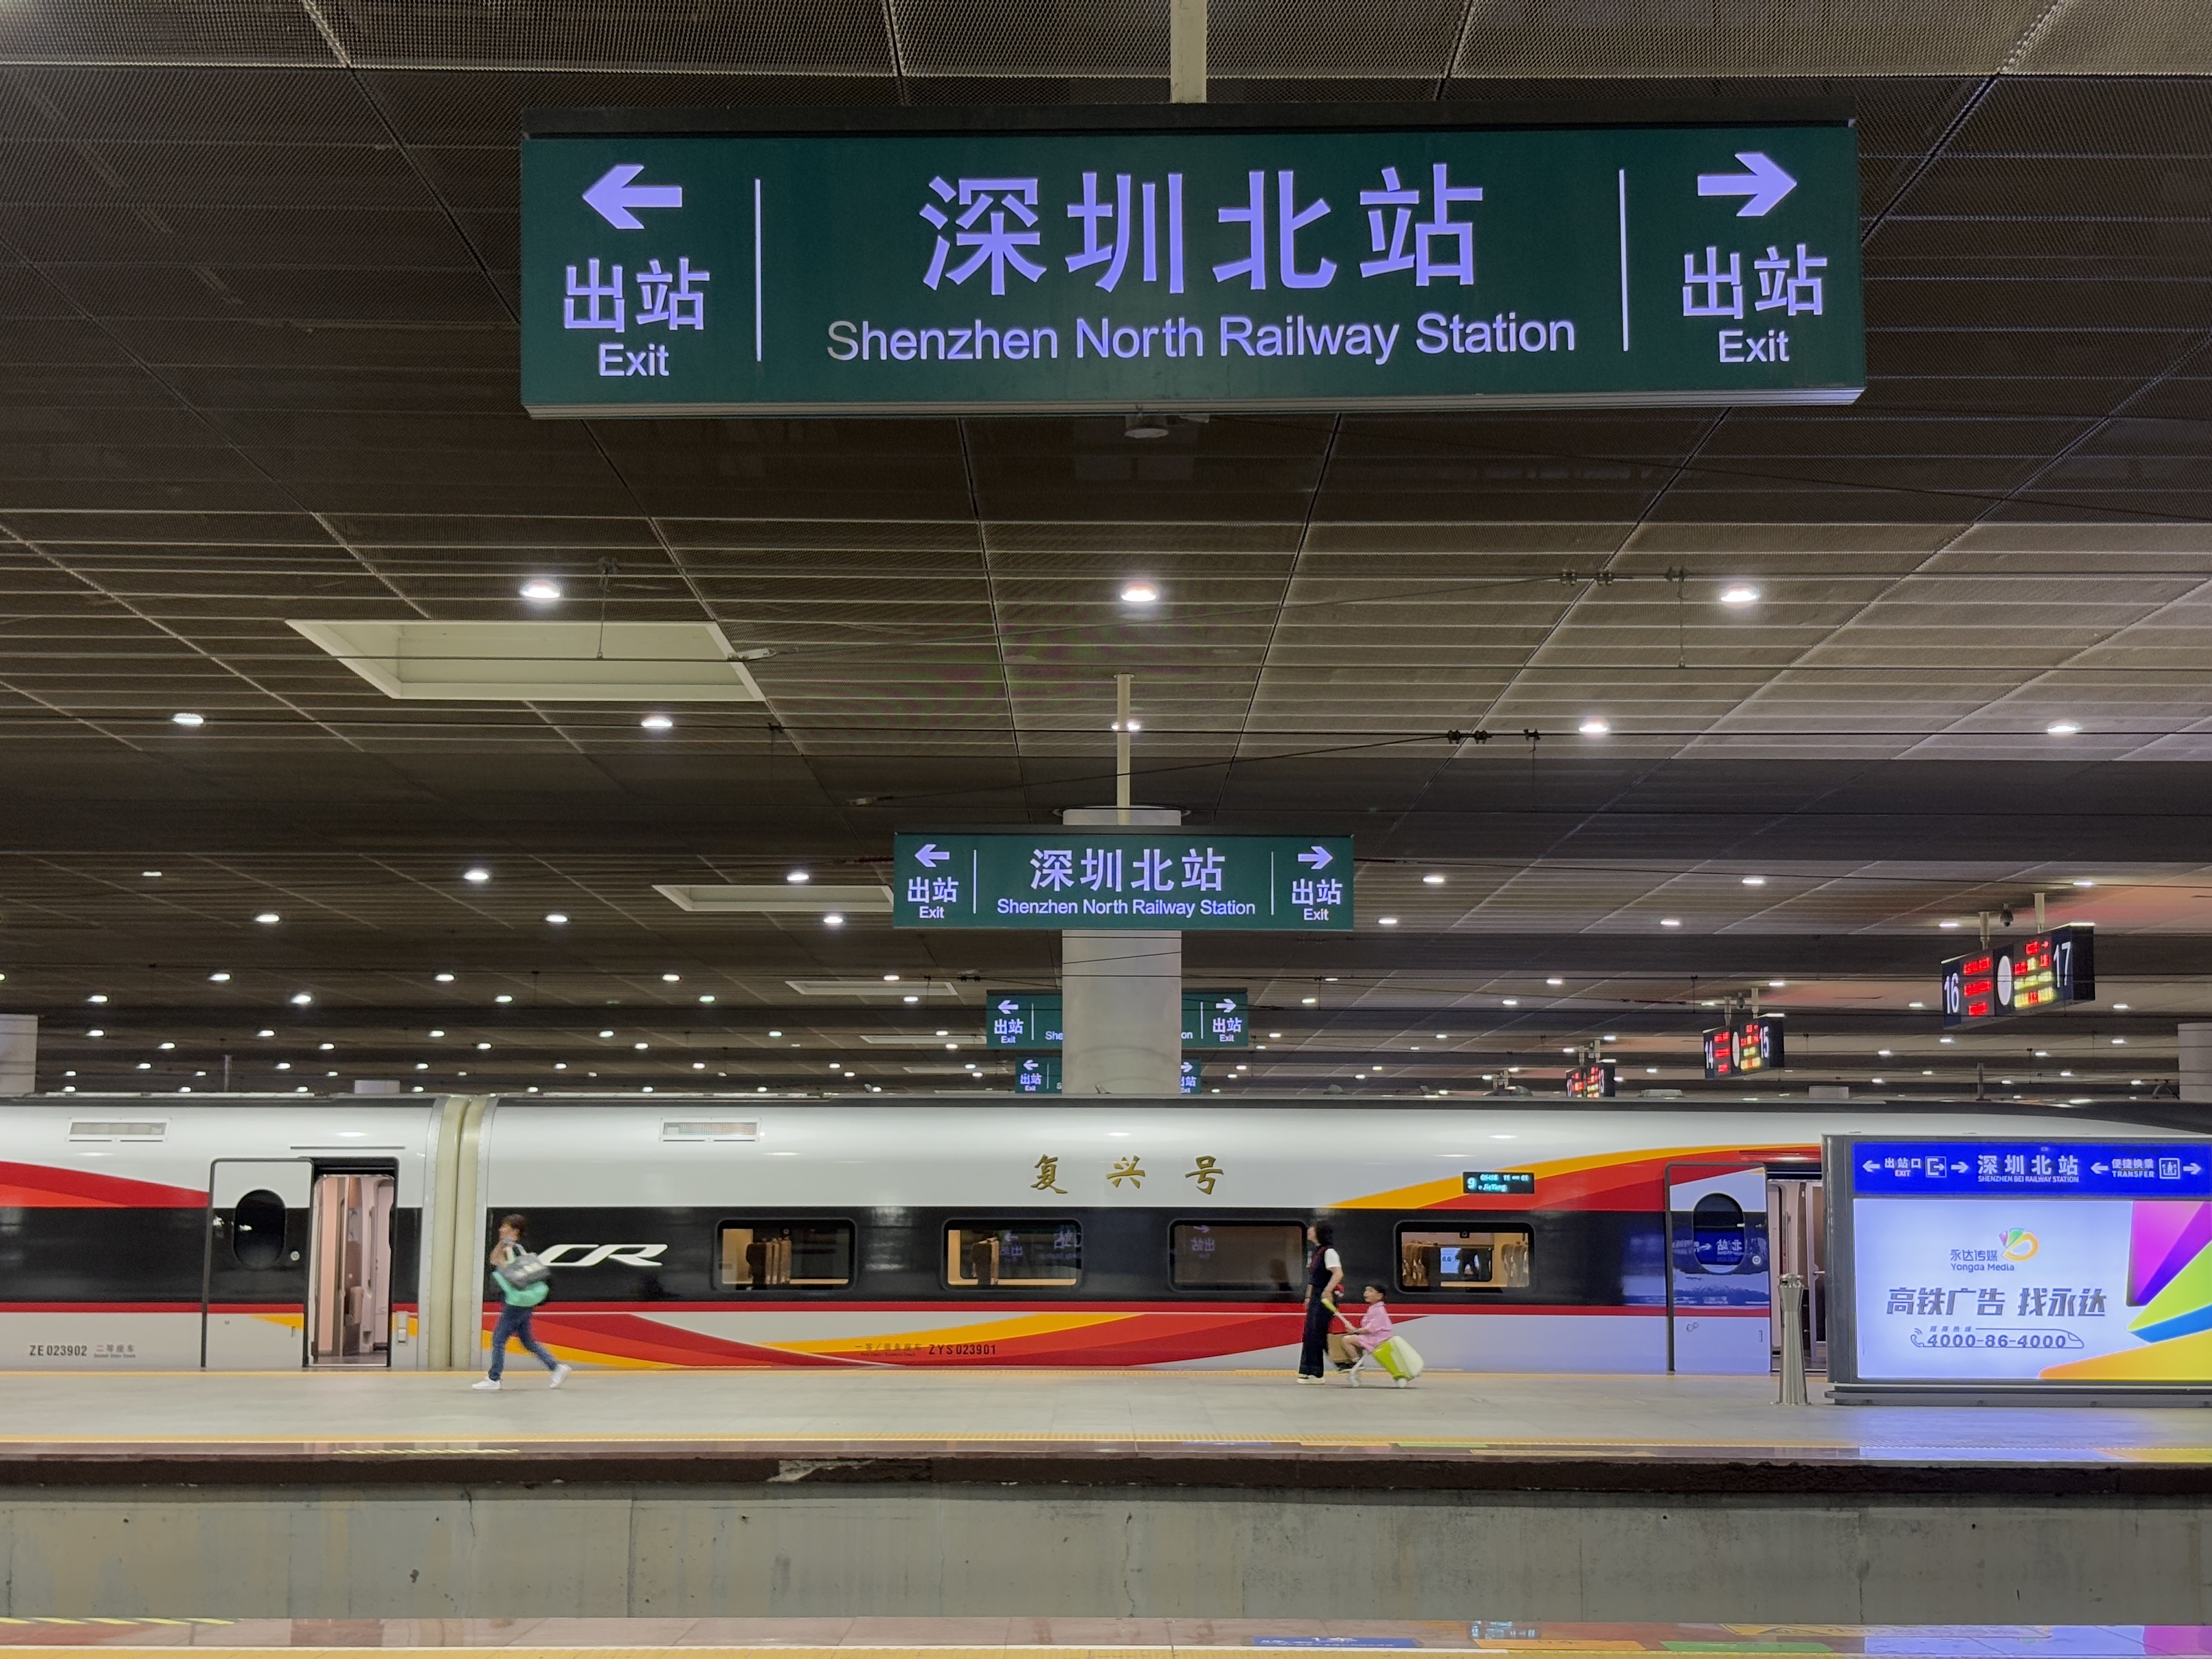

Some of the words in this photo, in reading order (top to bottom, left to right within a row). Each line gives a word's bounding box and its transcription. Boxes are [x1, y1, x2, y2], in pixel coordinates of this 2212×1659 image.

[919, 163, 1483, 295] 深圳北站
[564, 257, 710, 332] 出站
[1683, 244, 1827, 319] 出站
[827, 319, 1058, 360] Shenzhen
[1076, 318, 1204, 358] North
[1220, 315, 1400, 365] Railway
[1416, 312, 1575, 354] Station
[1719, 329, 1790, 363] Exit
[599, 343, 669, 376] Exit
[1030, 848, 1226, 892] 深圳北站
[907, 876, 959, 904] 出站
[1291, 878, 1343, 906] 出站
[919, 906, 945, 919] Exit
[997, 899, 1078, 915] Shenzhen
[1083, 899, 1128, 915] North
[1132, 899, 1196, 918] Railway
[1200, 899, 1256, 915] Station
[1304, 909, 1329, 921] Exit
[2053, 941, 2071, 988] 17
[1944, 973, 1960, 1014] 16
[994, 1018, 1024, 1035] 出站
[1212, 1017, 1242, 1033] 出站
[1705, 1040, 1713, 1069] 14
[1759, 1026, 1769, 1058] 15
[1020, 1073, 1042, 1085] 出站
[1030, 1154, 1224, 1195] 复兴号
[1884, 1157, 1921, 1169] 出站口
[1977, 1154, 2078, 1176] 深圳北站
[1467, 1177, 1477, 1190] 9
[1950, 1249, 1997, 1261] 永达传媒
[1950, 1263, 1984, 1273] Yongda
[1886, 1287, 2006, 1316] 高铁广告
[2017, 1287, 2107, 1317] 找永达
[30, 1345, 44, 1356] ZE
[47, 1345, 88, 1356] 023902
[929, 1344, 953, 1355] ZYS
[956, 1344, 996, 1355] 023901
[1927, 1334, 2067, 1347] 4000-86-4000
